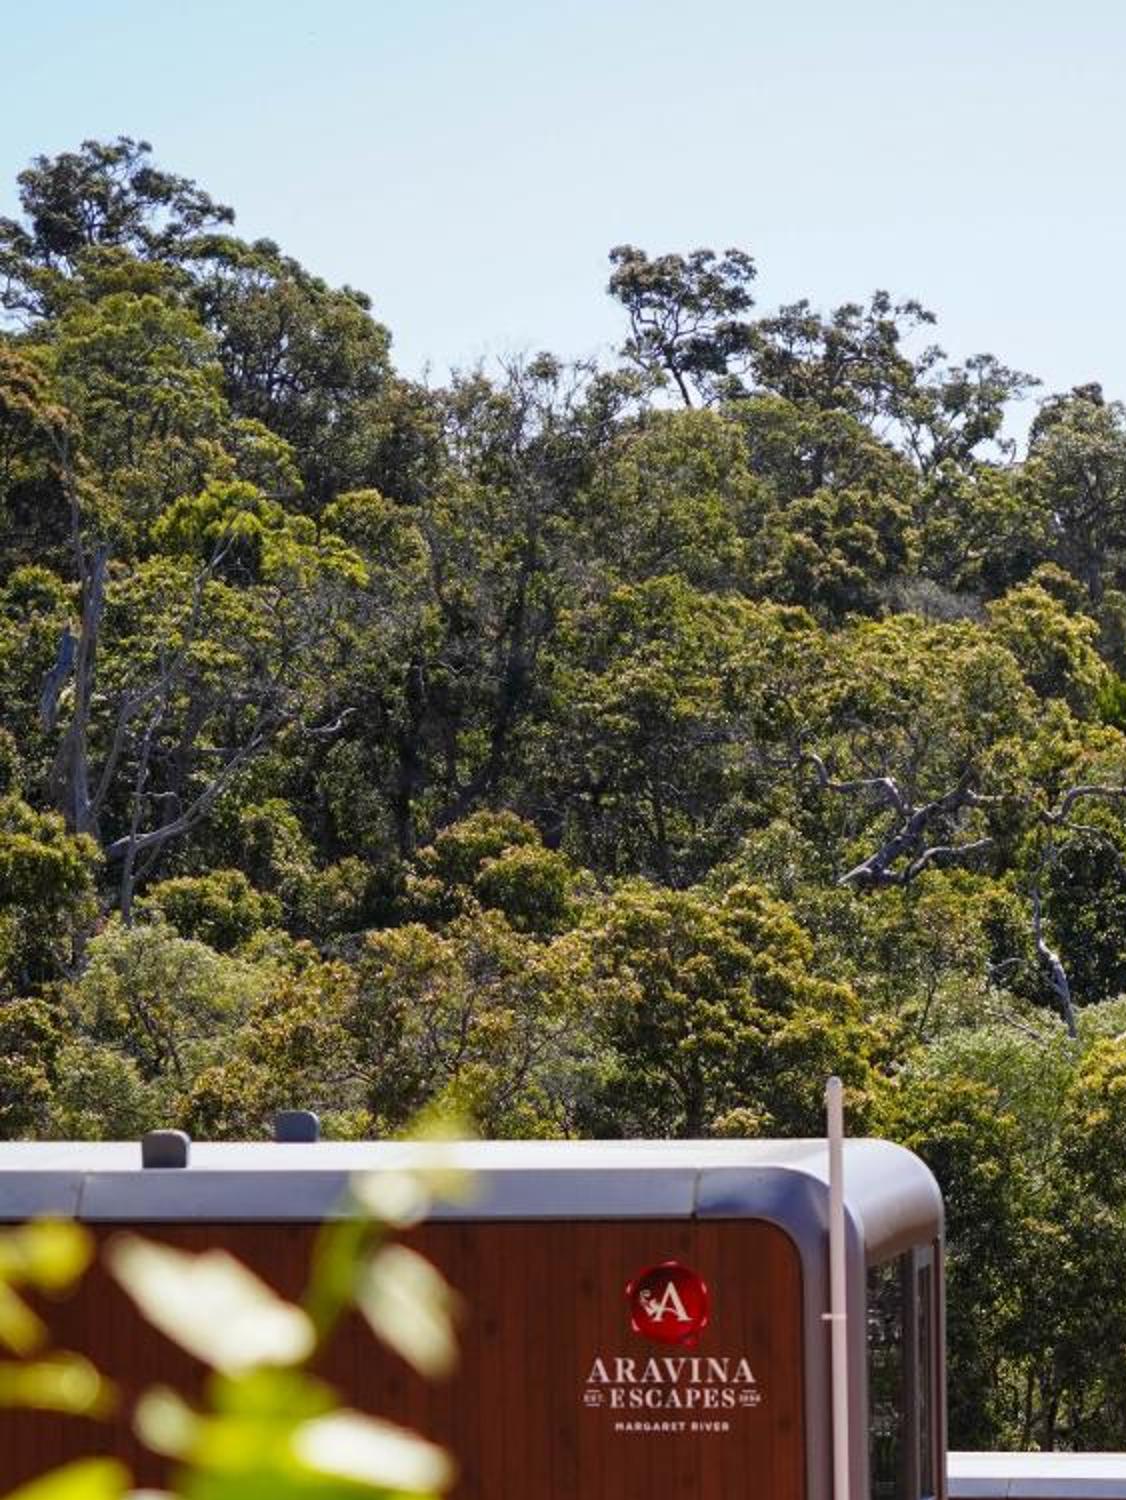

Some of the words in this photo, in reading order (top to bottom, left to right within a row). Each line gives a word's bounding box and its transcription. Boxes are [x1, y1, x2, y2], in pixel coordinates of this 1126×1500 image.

[586, 1357, 756, 1383] ARAVINA
[609, 1388, 736, 1409] ESCAPES
[615, 1421, 686, 1432] MARGARET
[691, 1421, 730, 1432] RIVER
